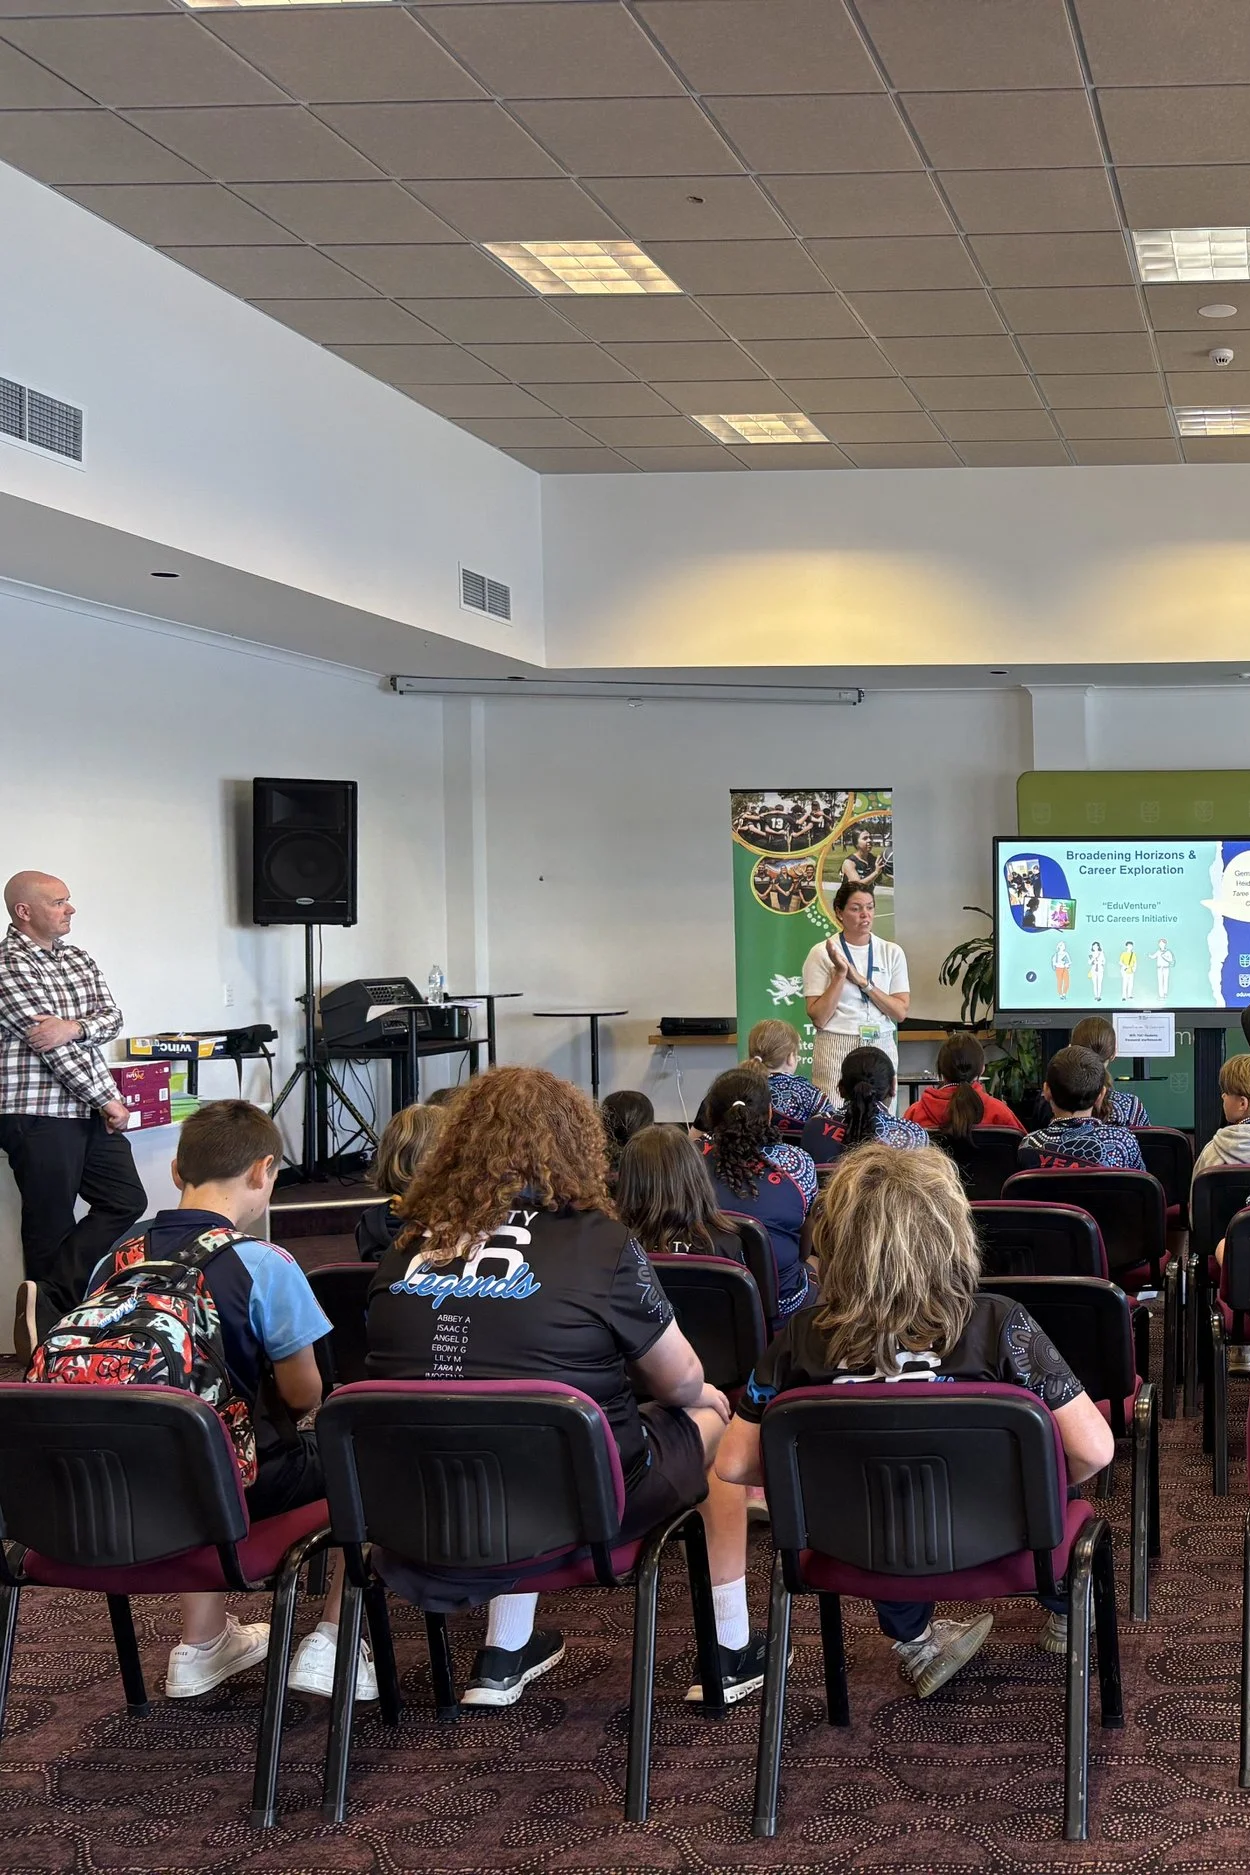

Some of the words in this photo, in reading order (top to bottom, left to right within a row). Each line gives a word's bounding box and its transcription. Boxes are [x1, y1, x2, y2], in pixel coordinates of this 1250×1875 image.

[1066, 850, 1131, 862] Broadening
[1135, 850, 1185, 860] Horizons
[1188, 850, 1197, 860] &
[1079, 865, 1116, 875] Career
[1119, 865, 1184, 876] Exploration
[1085, 915, 1105, 923] TUC
[1106, 915, 1140, 923] Careers
[1142, 914, 1178, 923] Initiative
[389, 1261, 541, 1310] Legends
[437, 1314, 463, 1323] ABBEY
[436, 1324, 460, 1333] ISAAC
[461, 1326, 468, 1334] C
[433, 1334, 460, 1344] ANGEL
[462, 1336, 469, 1344] D
[431, 1343, 459, 1353] EBONY
[460, 1346, 467, 1354] G
[434, 1354, 452, 1362] LILY
[432, 1363, 453, 1371] TARA
